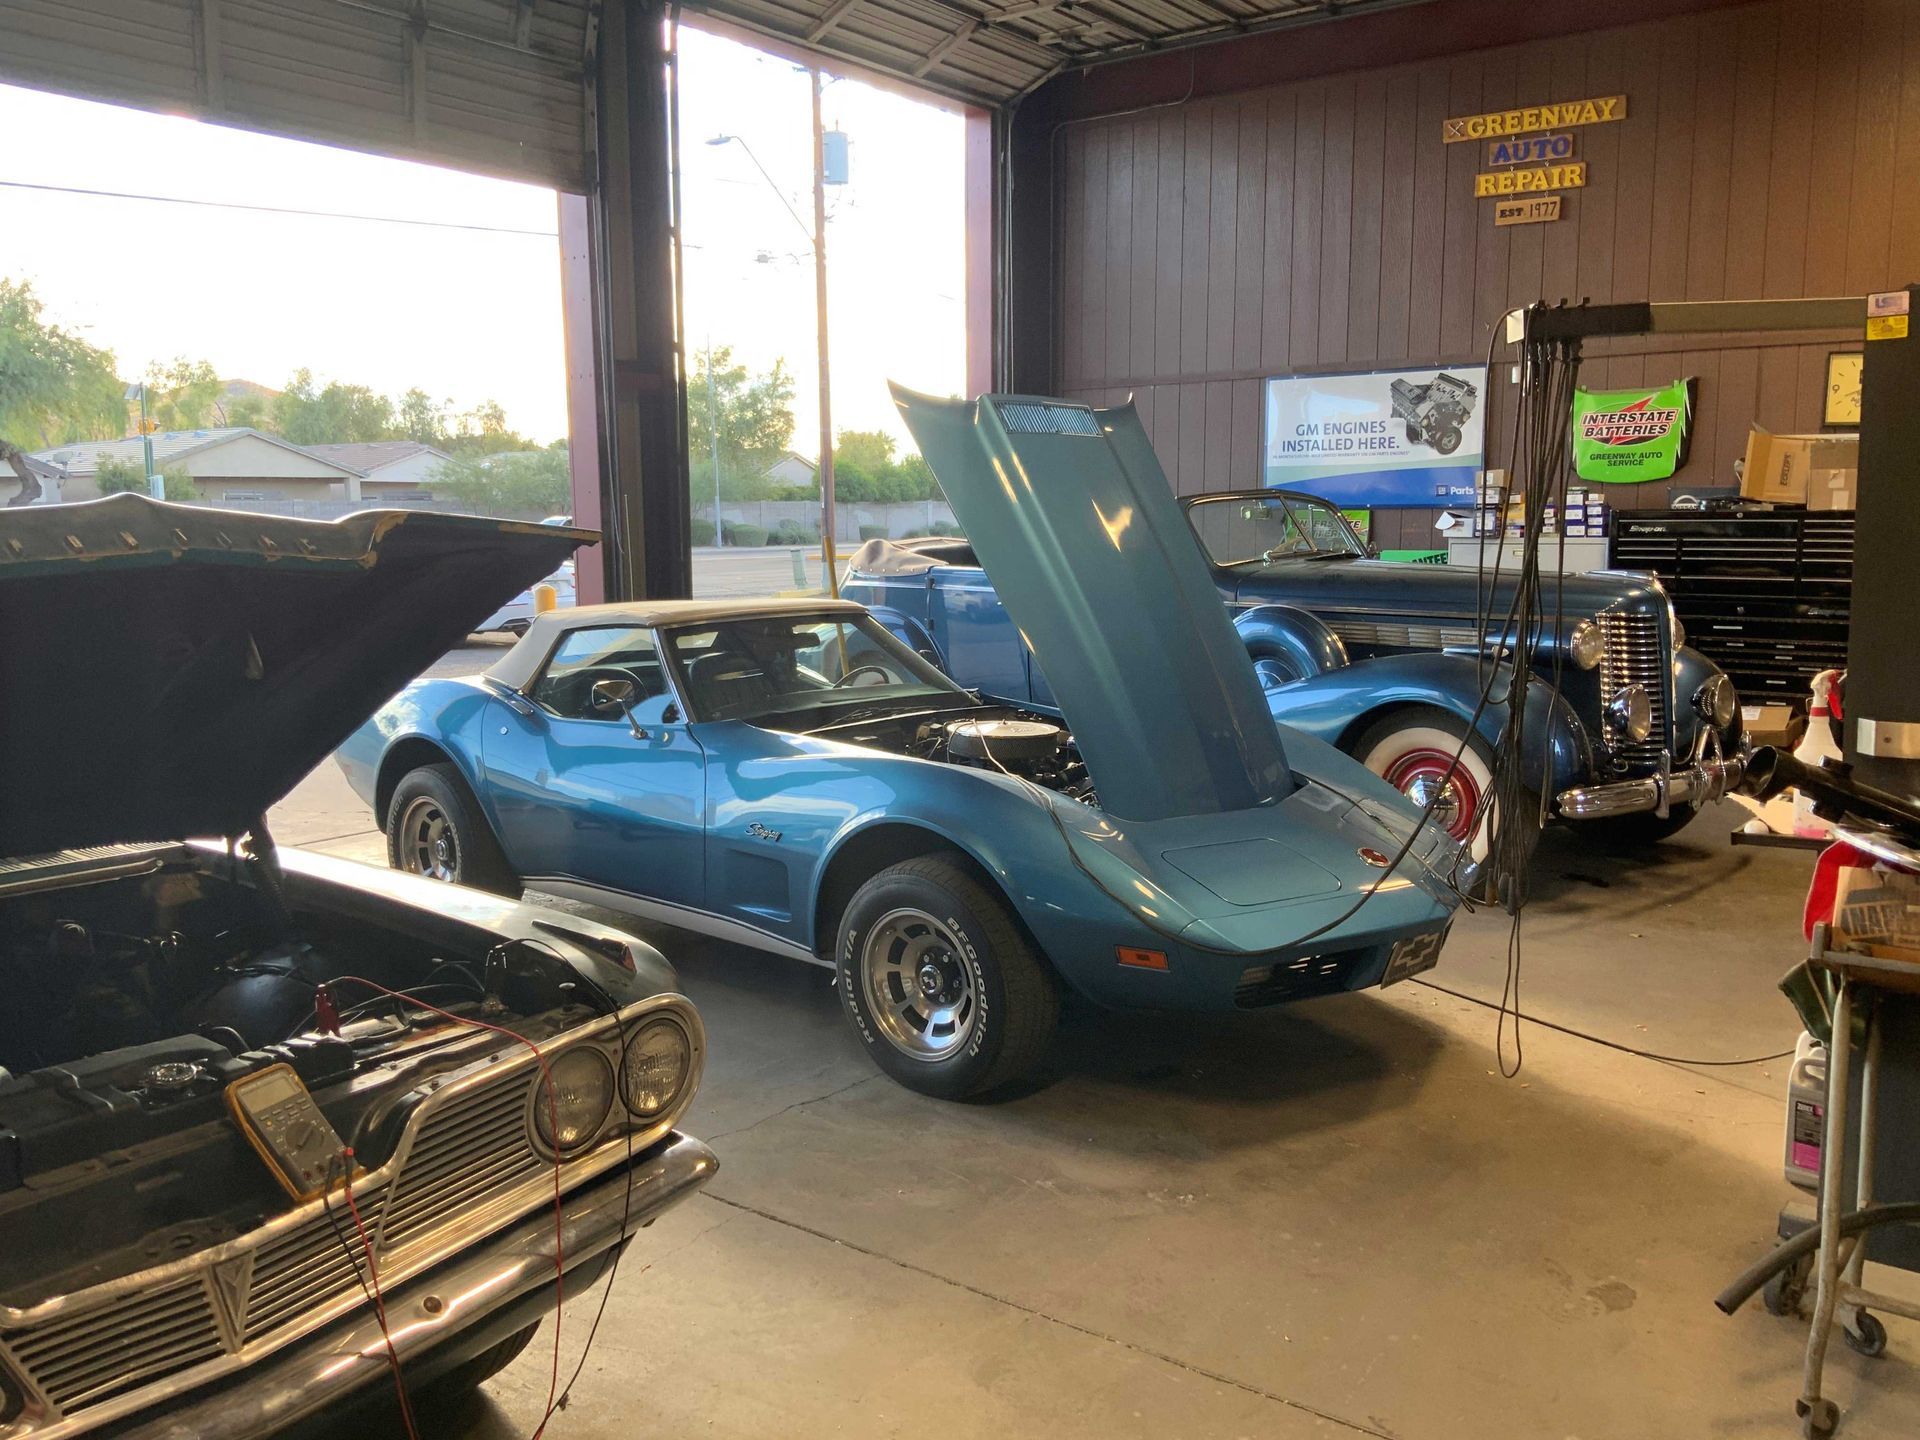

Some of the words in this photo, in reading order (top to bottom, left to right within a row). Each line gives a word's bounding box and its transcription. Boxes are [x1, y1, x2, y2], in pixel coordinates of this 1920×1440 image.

[1467, 99, 1617, 138] GREENWAY
[1491, 136, 1570, 164] AUTO
[1478, 165, 1582, 195] REPAIR
[1530, 201, 1557, 218] 1977
[1832, 384, 1840, 394] 9
[1583, 411, 1675, 425] INTERSTATE
[1295, 424, 1319, 437] GM
[1323, 420, 1386, 436] ENGINES
[1584, 424, 1669, 437] BATTERIES
[1282, 437, 1354, 452] INSTALLED
[1358, 436, 1400, 450] HERE.
[1590, 453, 1637, 461] GREENWAY
[1639, 451, 1663, 459] AUTO
[1607, 459, 1644, 467] SERVICE
[1450, 486, 1474, 495] Parts
[1629, 525, 1667, 533] Snap-on
